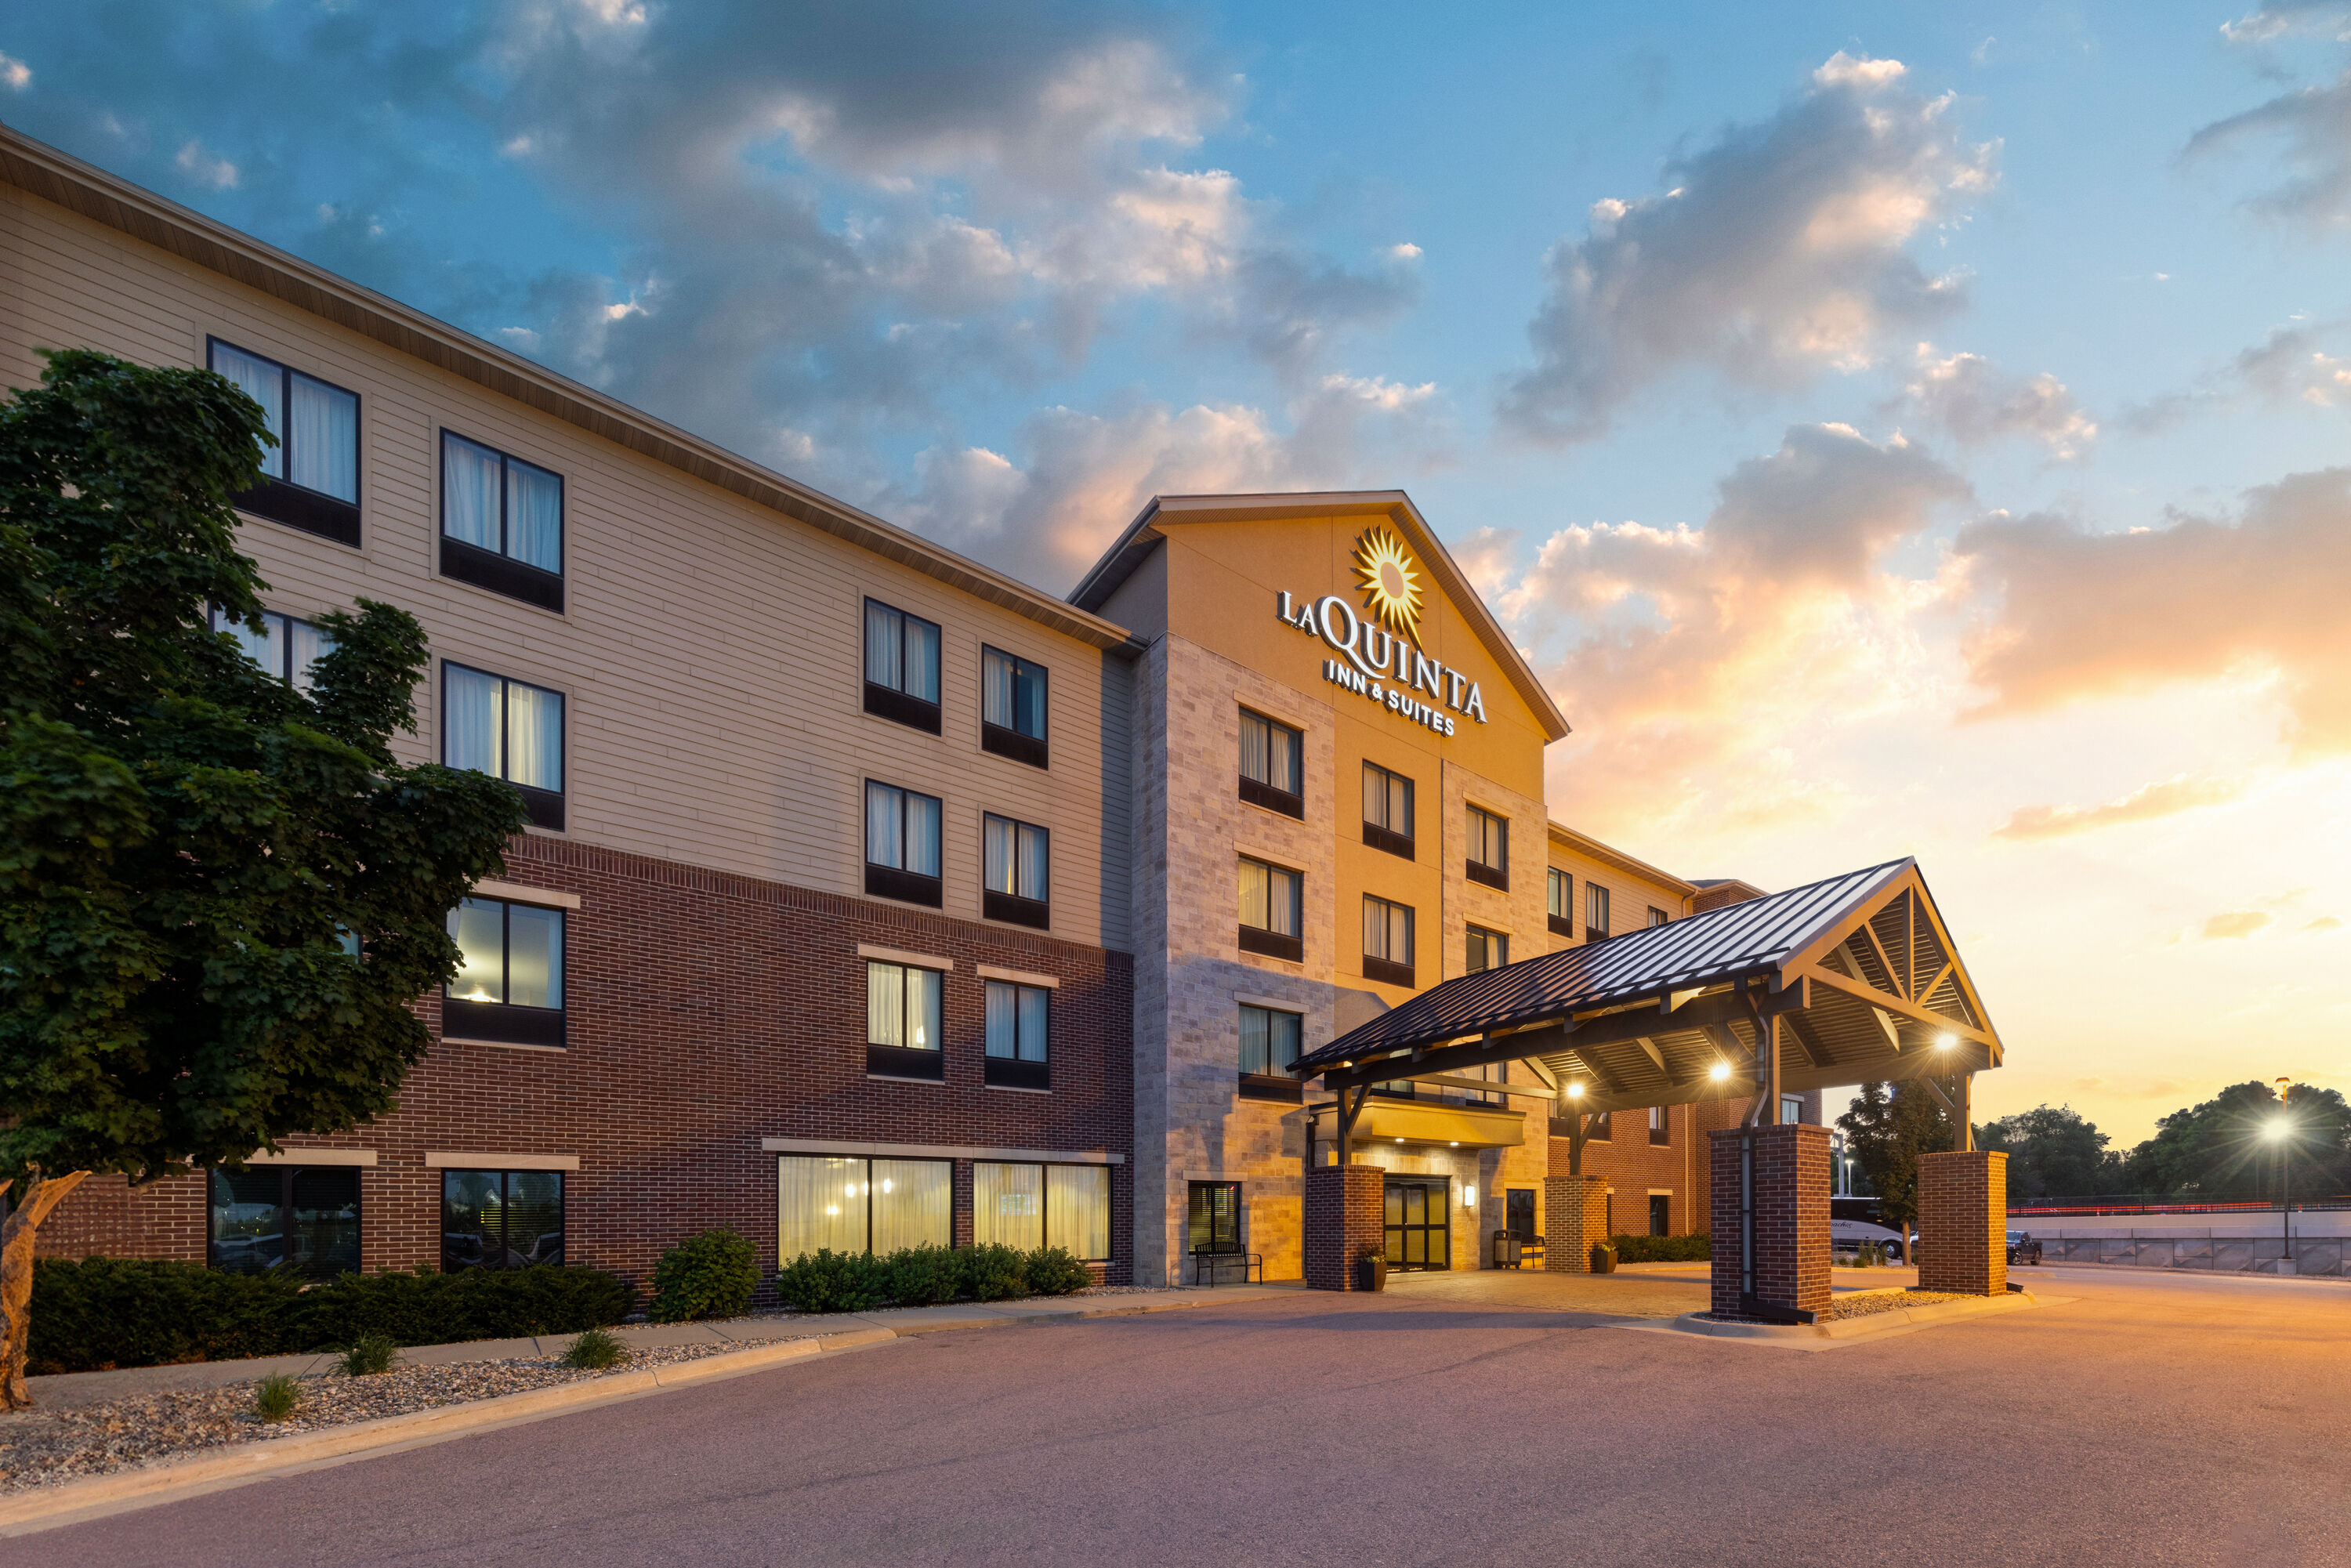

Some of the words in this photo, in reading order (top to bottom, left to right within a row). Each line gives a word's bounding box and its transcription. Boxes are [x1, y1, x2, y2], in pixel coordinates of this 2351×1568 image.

[1277, 590, 1318, 636] LA
[1317, 596, 1487, 724] QUINTA
[1325, 659, 1366, 695] INN
[1370, 682, 1383, 701] &
[1386, 689, 1454, 737] SUITES
